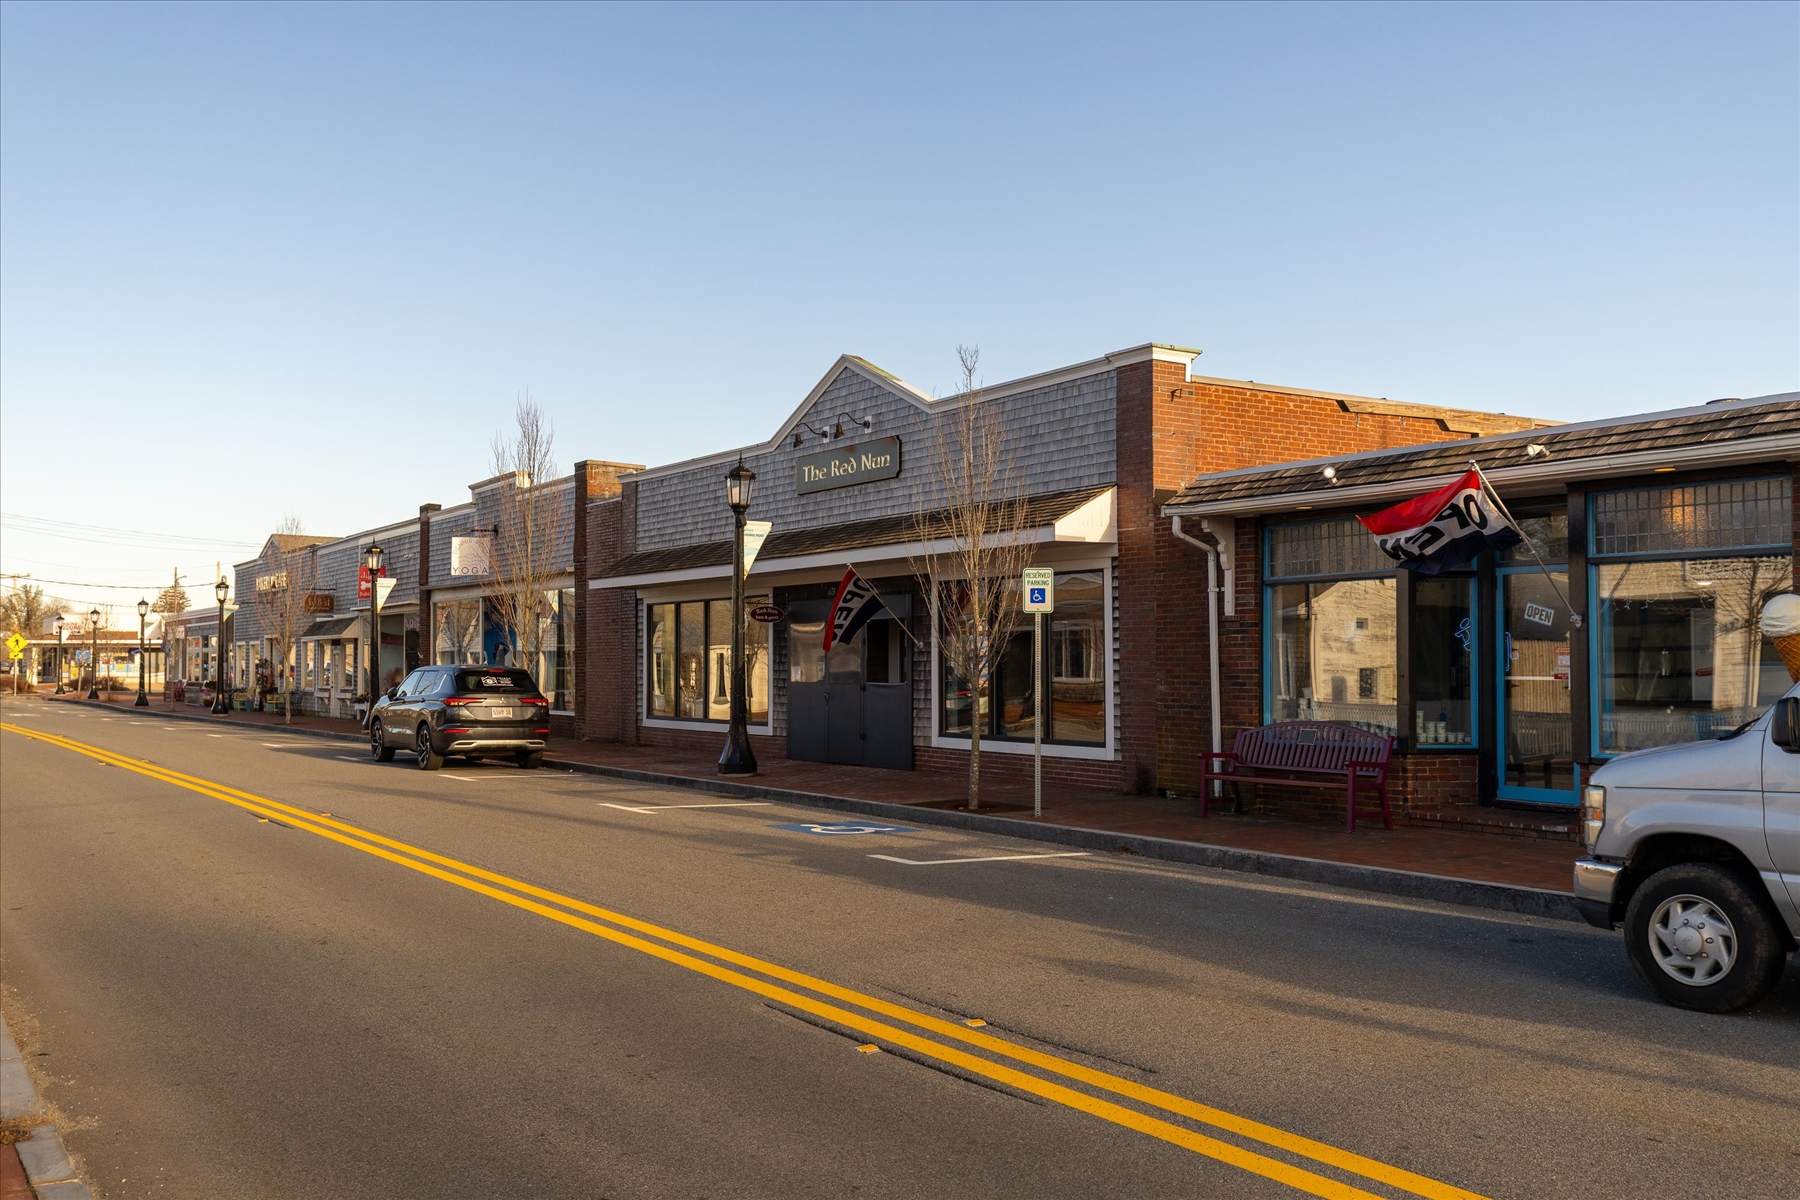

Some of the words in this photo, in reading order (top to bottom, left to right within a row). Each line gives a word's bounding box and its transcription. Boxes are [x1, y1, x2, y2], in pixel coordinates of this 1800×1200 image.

[802, 465, 826, 482] The
[831, 457, 857, 477] Red
[861, 453, 890, 471] Nun
[452, 566, 488, 575] YOGA
[1526, 605, 1553, 624] OPEN
